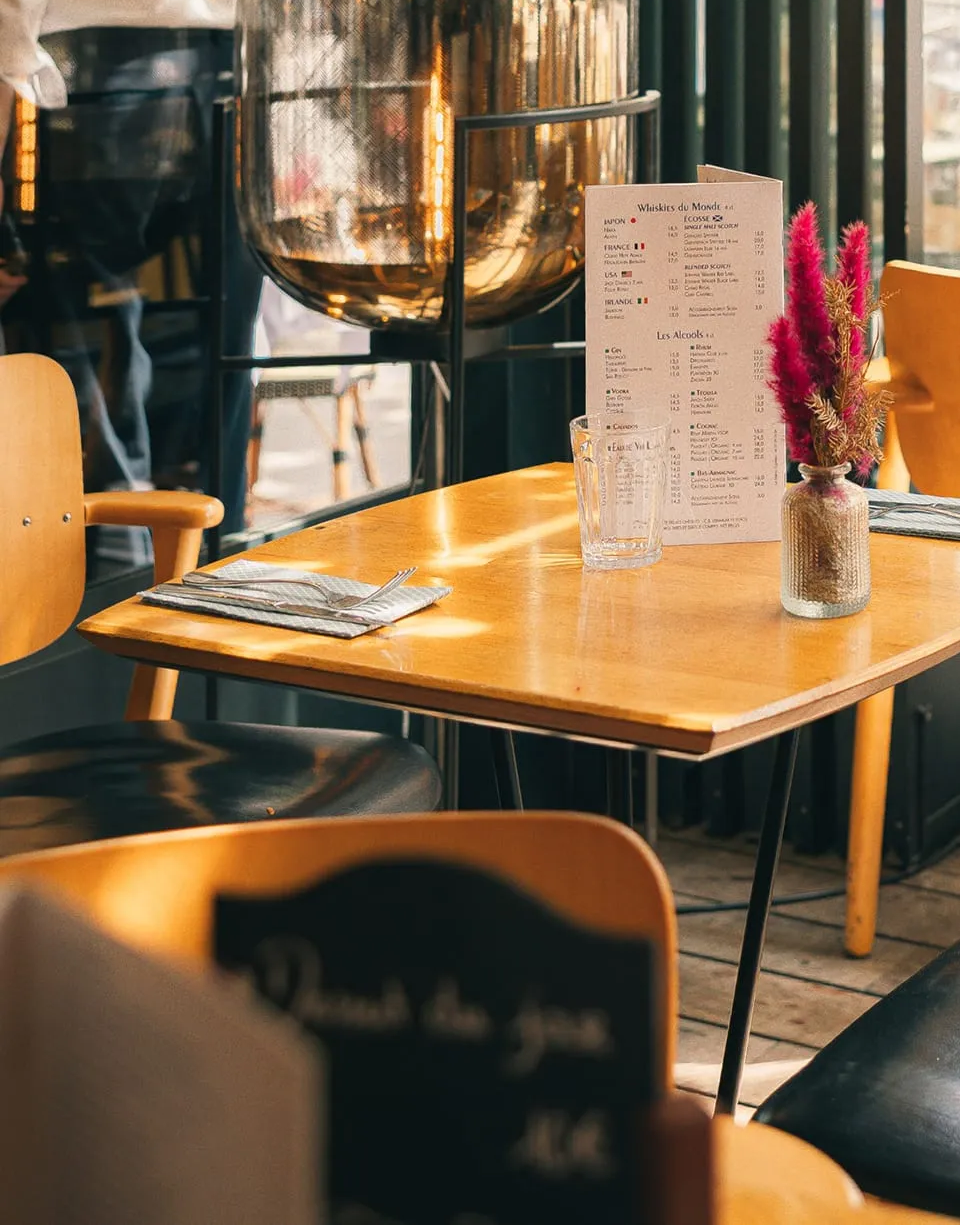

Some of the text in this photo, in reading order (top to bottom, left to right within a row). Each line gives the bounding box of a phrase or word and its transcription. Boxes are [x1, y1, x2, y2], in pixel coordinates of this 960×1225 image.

[637, 203, 675, 212] Whiskies
[678, 202, 689, 211] du
[692, 201, 721, 211] Monde
[604, 298, 634, 306] IRLANDE
[657, 331, 670, 340] Les
[672, 330, 704, 339] Alcools
